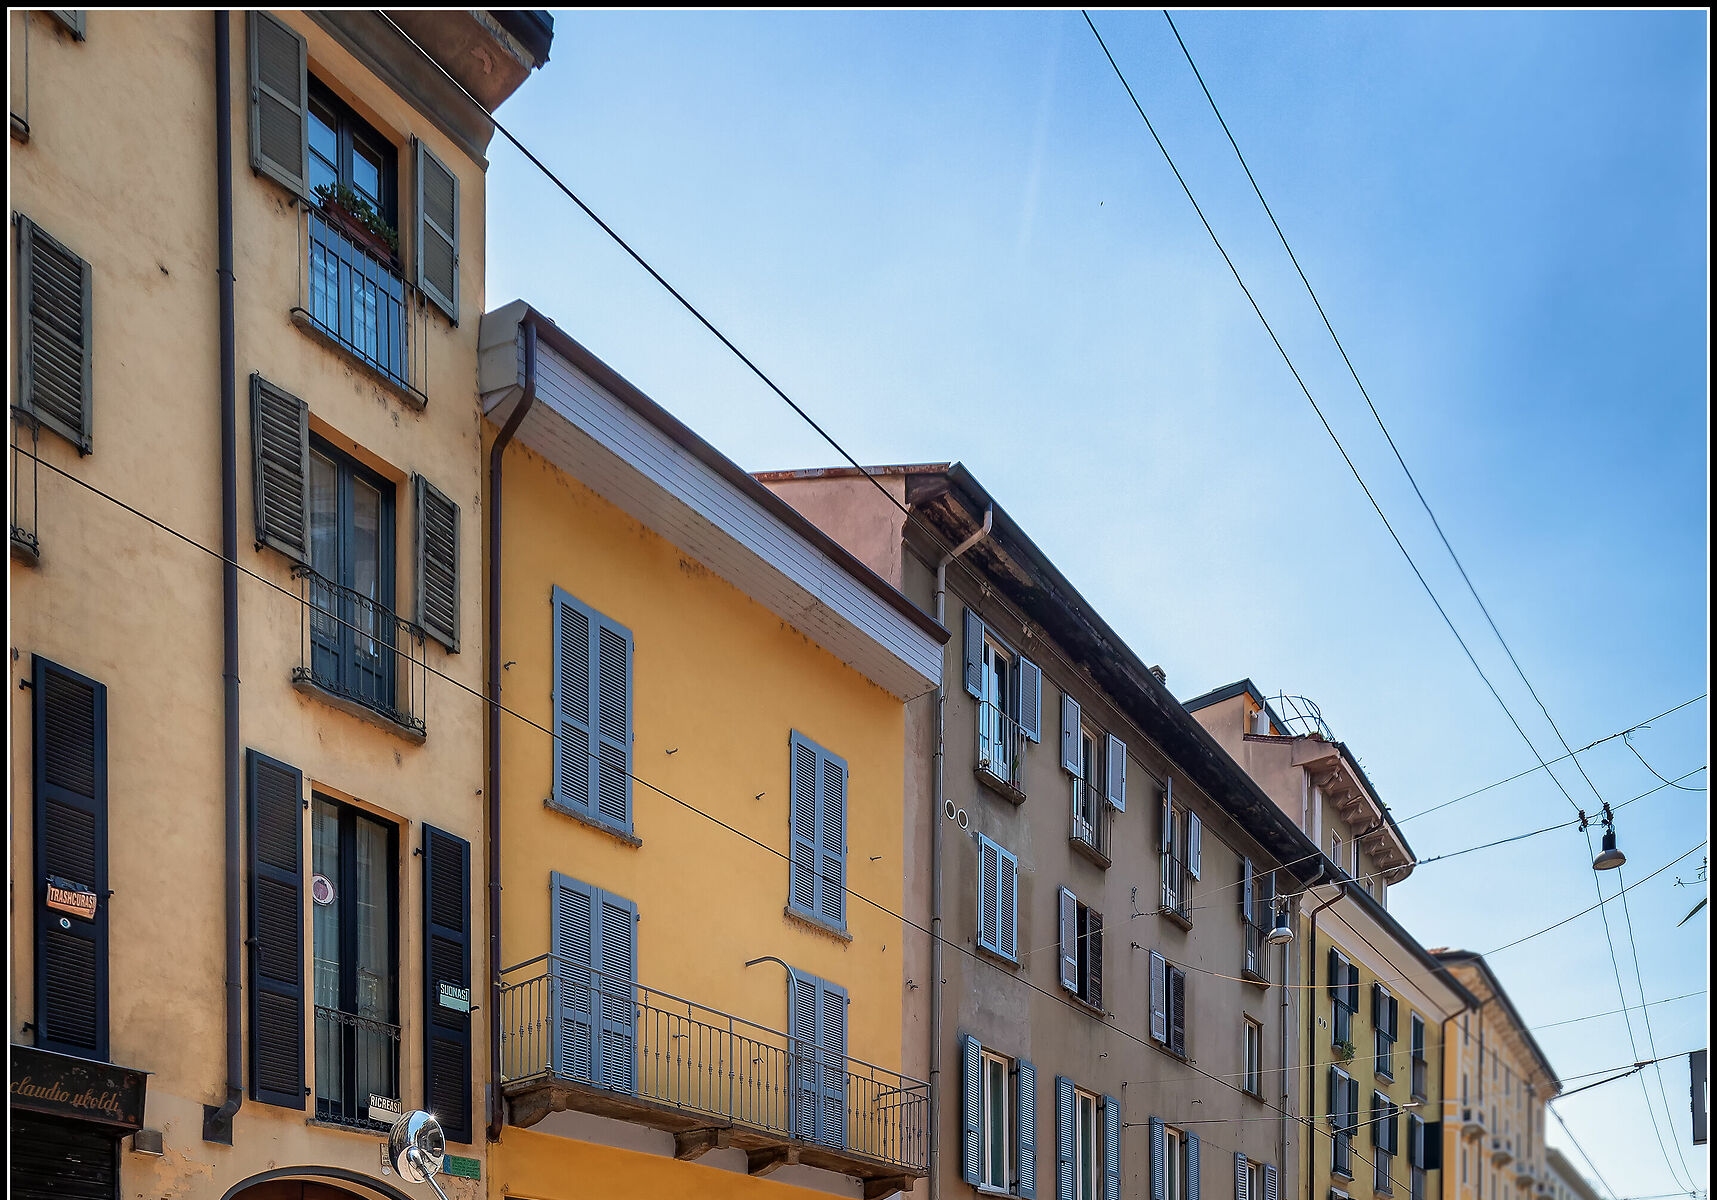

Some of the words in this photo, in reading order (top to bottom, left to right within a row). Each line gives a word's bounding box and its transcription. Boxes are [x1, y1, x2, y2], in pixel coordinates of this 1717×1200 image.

[440, 983, 468, 1001] SUONASI
[10, 1076, 71, 1103] claudio
[370, 1095, 401, 1114] RICREASI
